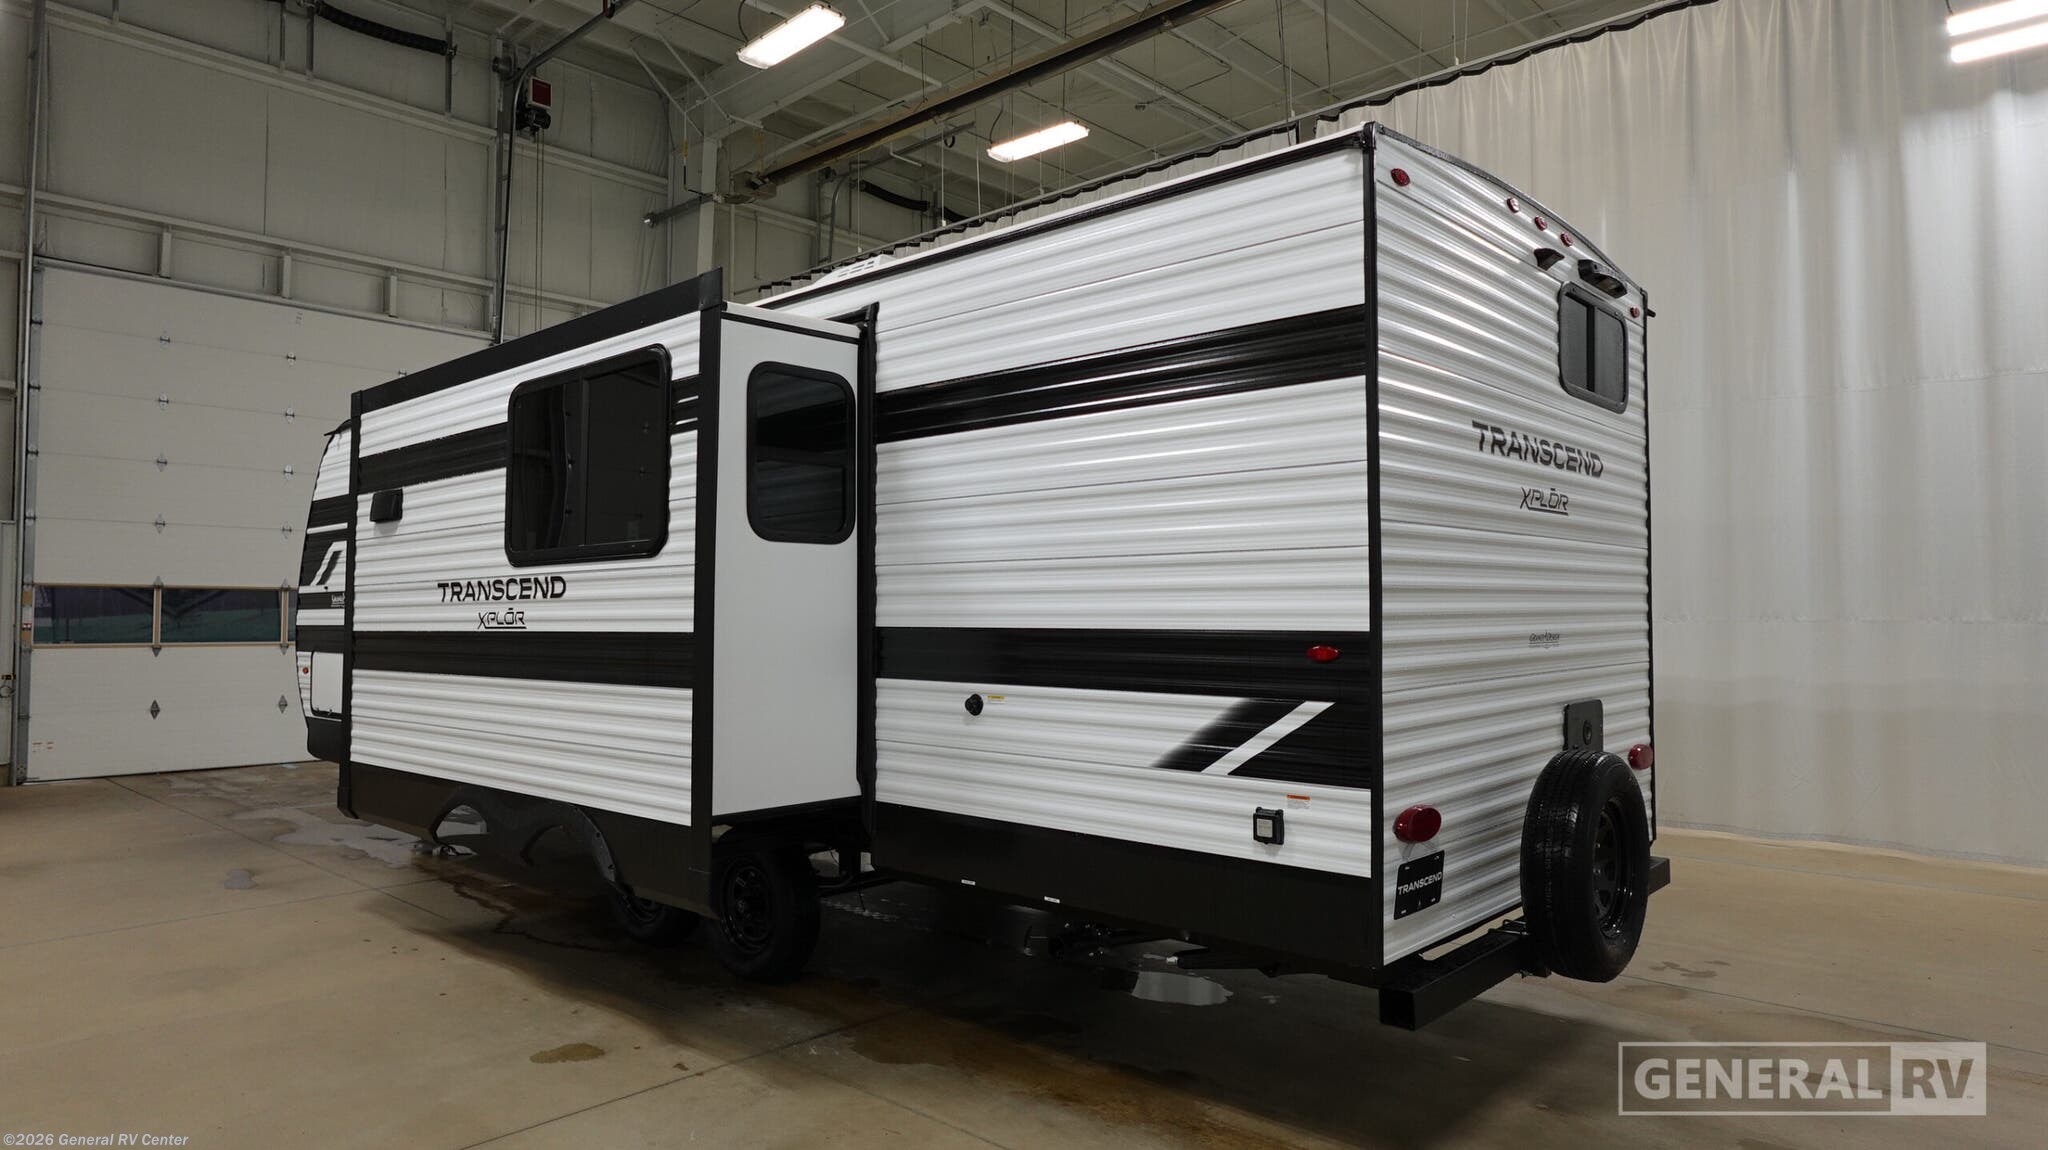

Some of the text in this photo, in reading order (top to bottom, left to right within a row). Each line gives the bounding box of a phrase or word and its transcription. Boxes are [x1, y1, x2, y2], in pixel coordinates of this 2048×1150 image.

[1472, 420, 1603, 478] TRANSCEND
[437, 576, 566, 602] TRANSCEND
[1398, 871, 1443, 895] TRANSCEND
